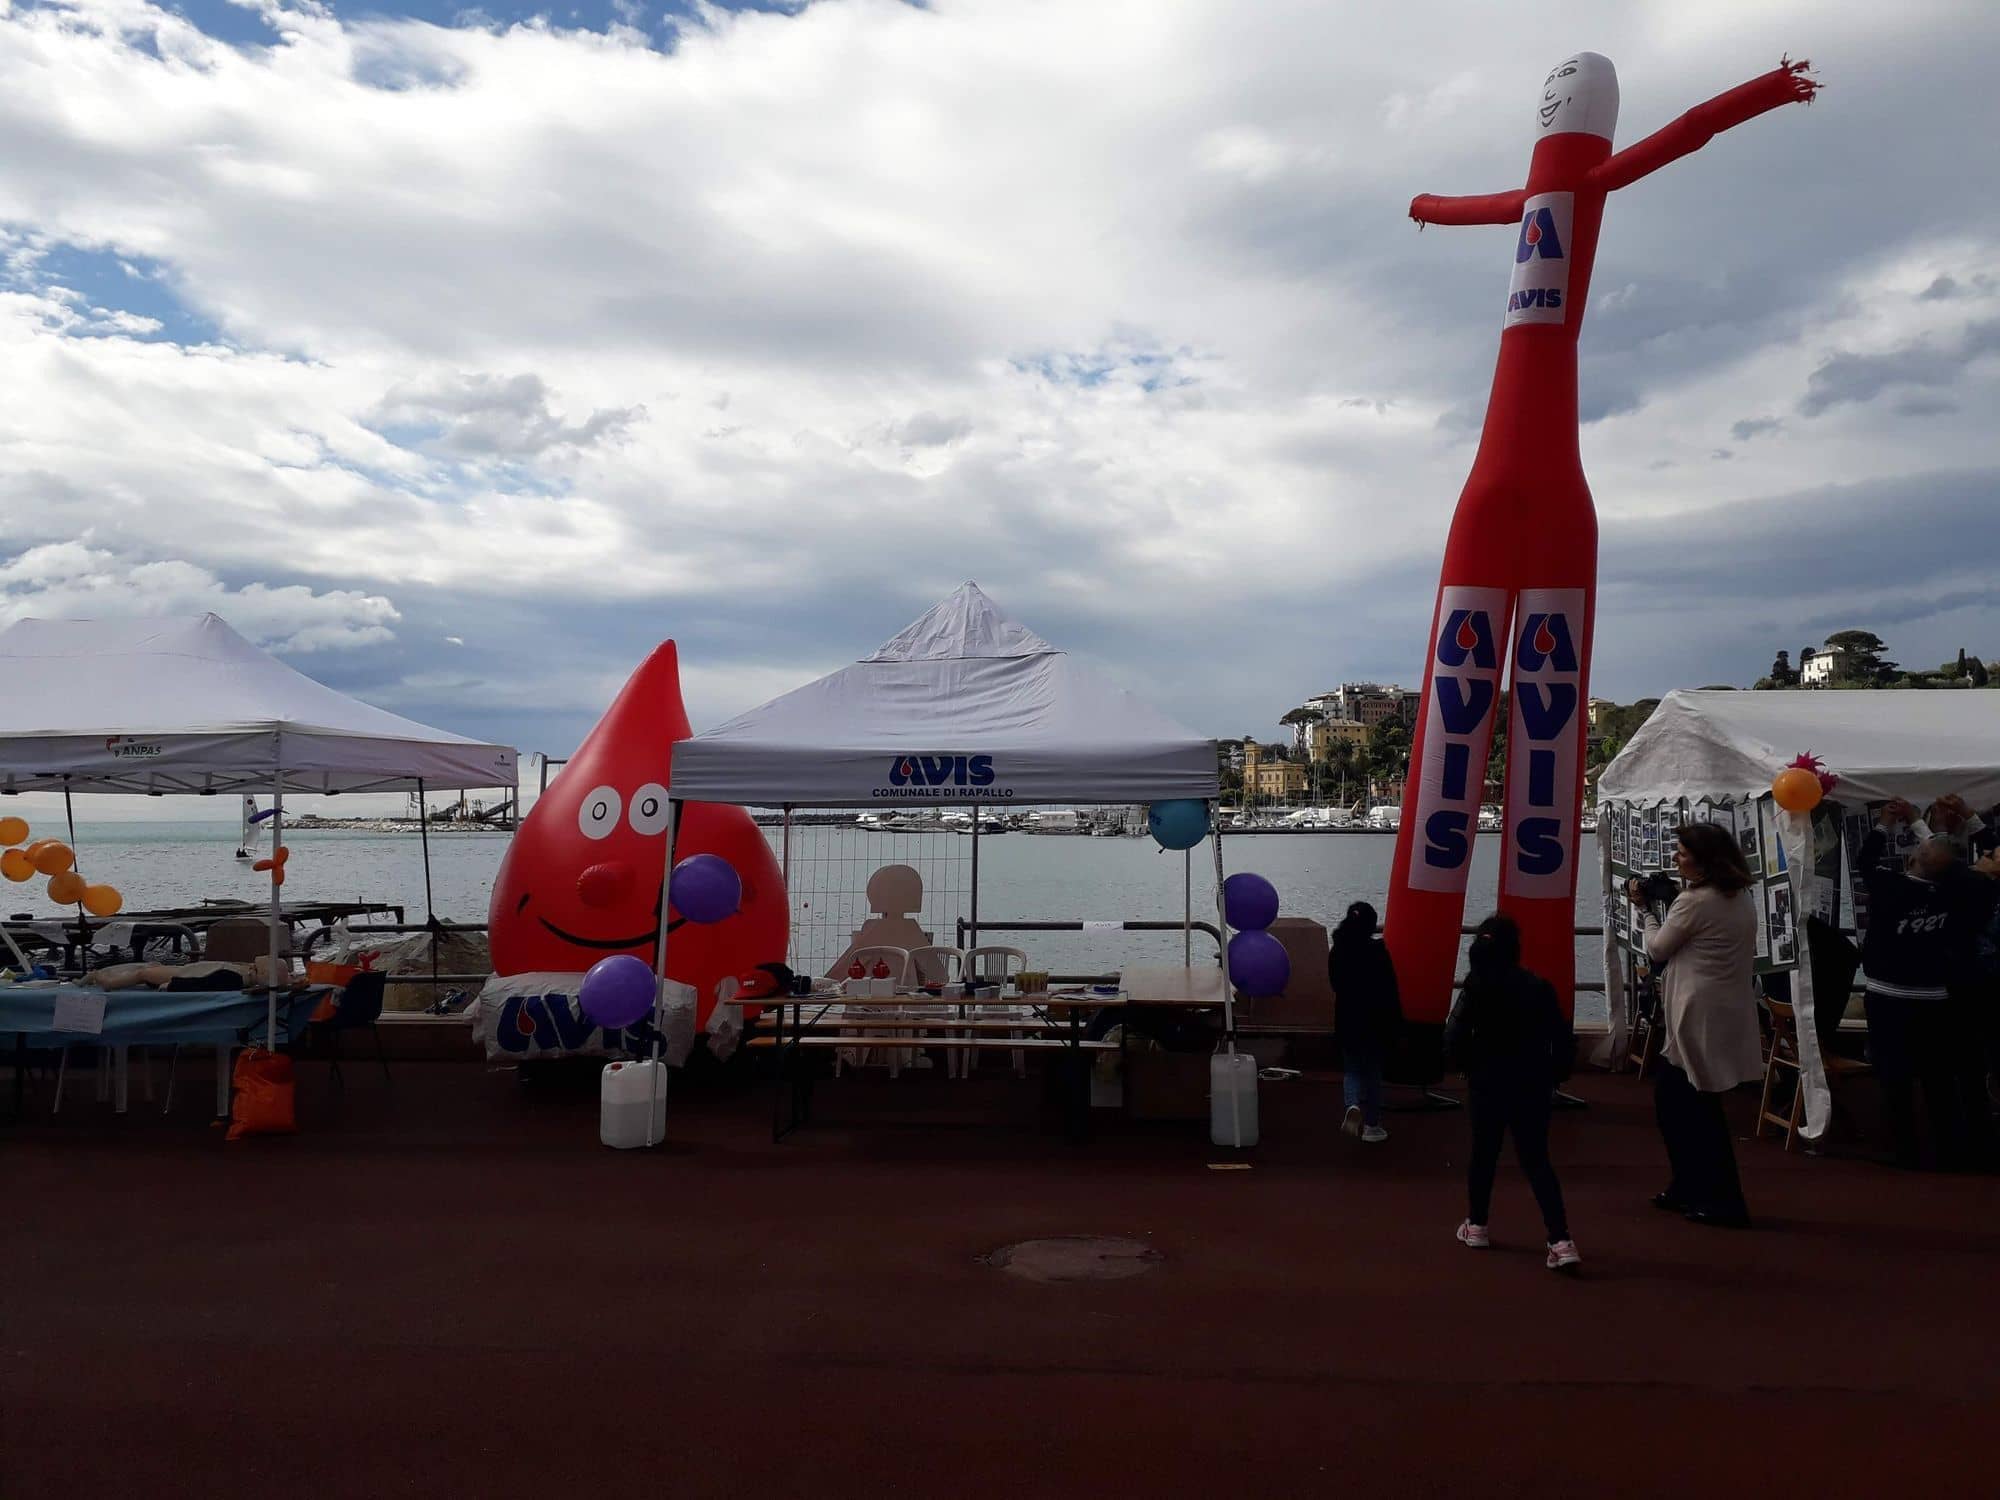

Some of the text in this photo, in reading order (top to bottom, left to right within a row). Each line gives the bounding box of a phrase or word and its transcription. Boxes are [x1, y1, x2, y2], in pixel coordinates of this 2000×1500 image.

[1508, 288, 1562, 312] AVIS
[122, 745, 161, 756] ANPAS
[1425, 609, 1497, 869] AVIS
[1516, 613, 1579, 875] AVIS
[889, 755, 996, 786] AVIS
[872, 788, 1014, 798] COMUNALE DI RAPALLO
